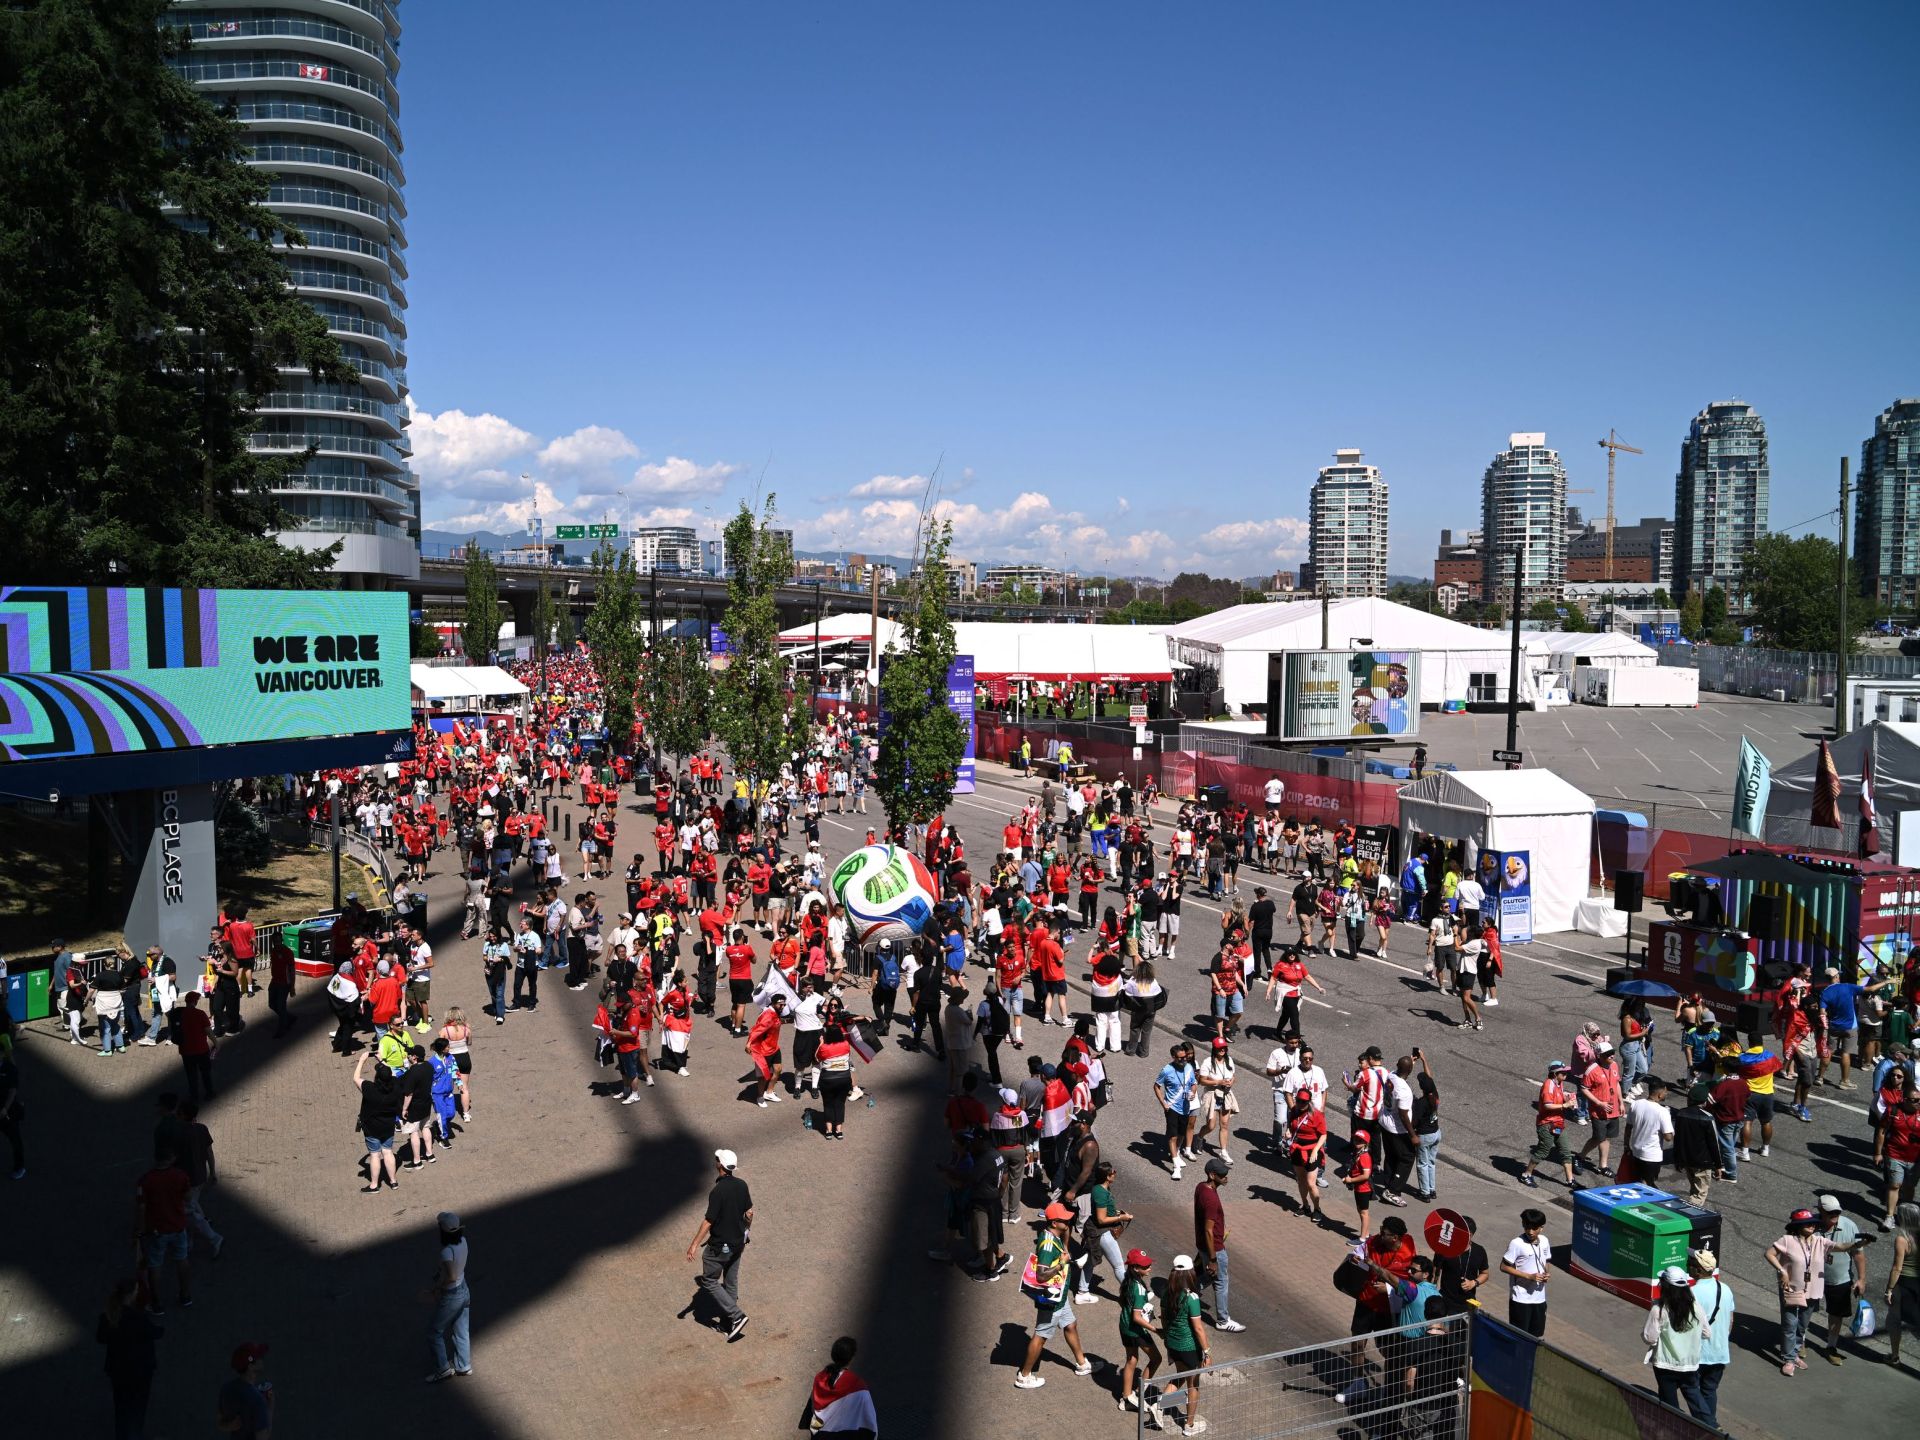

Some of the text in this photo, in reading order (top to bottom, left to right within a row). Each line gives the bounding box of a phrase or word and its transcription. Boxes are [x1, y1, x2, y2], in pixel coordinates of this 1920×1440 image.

[253, 636, 308, 664] WE
[255, 668, 380, 693] VANCOUVER
[1235, 783, 1340, 811] FIFA WOD CUP 2026
[1742, 755, 1761, 820] WELCOME
[1357, 850, 1380, 860] FIELD
[1663, 966, 1681, 975] 2026
[1715, 1002, 1737, 1012] 2026
